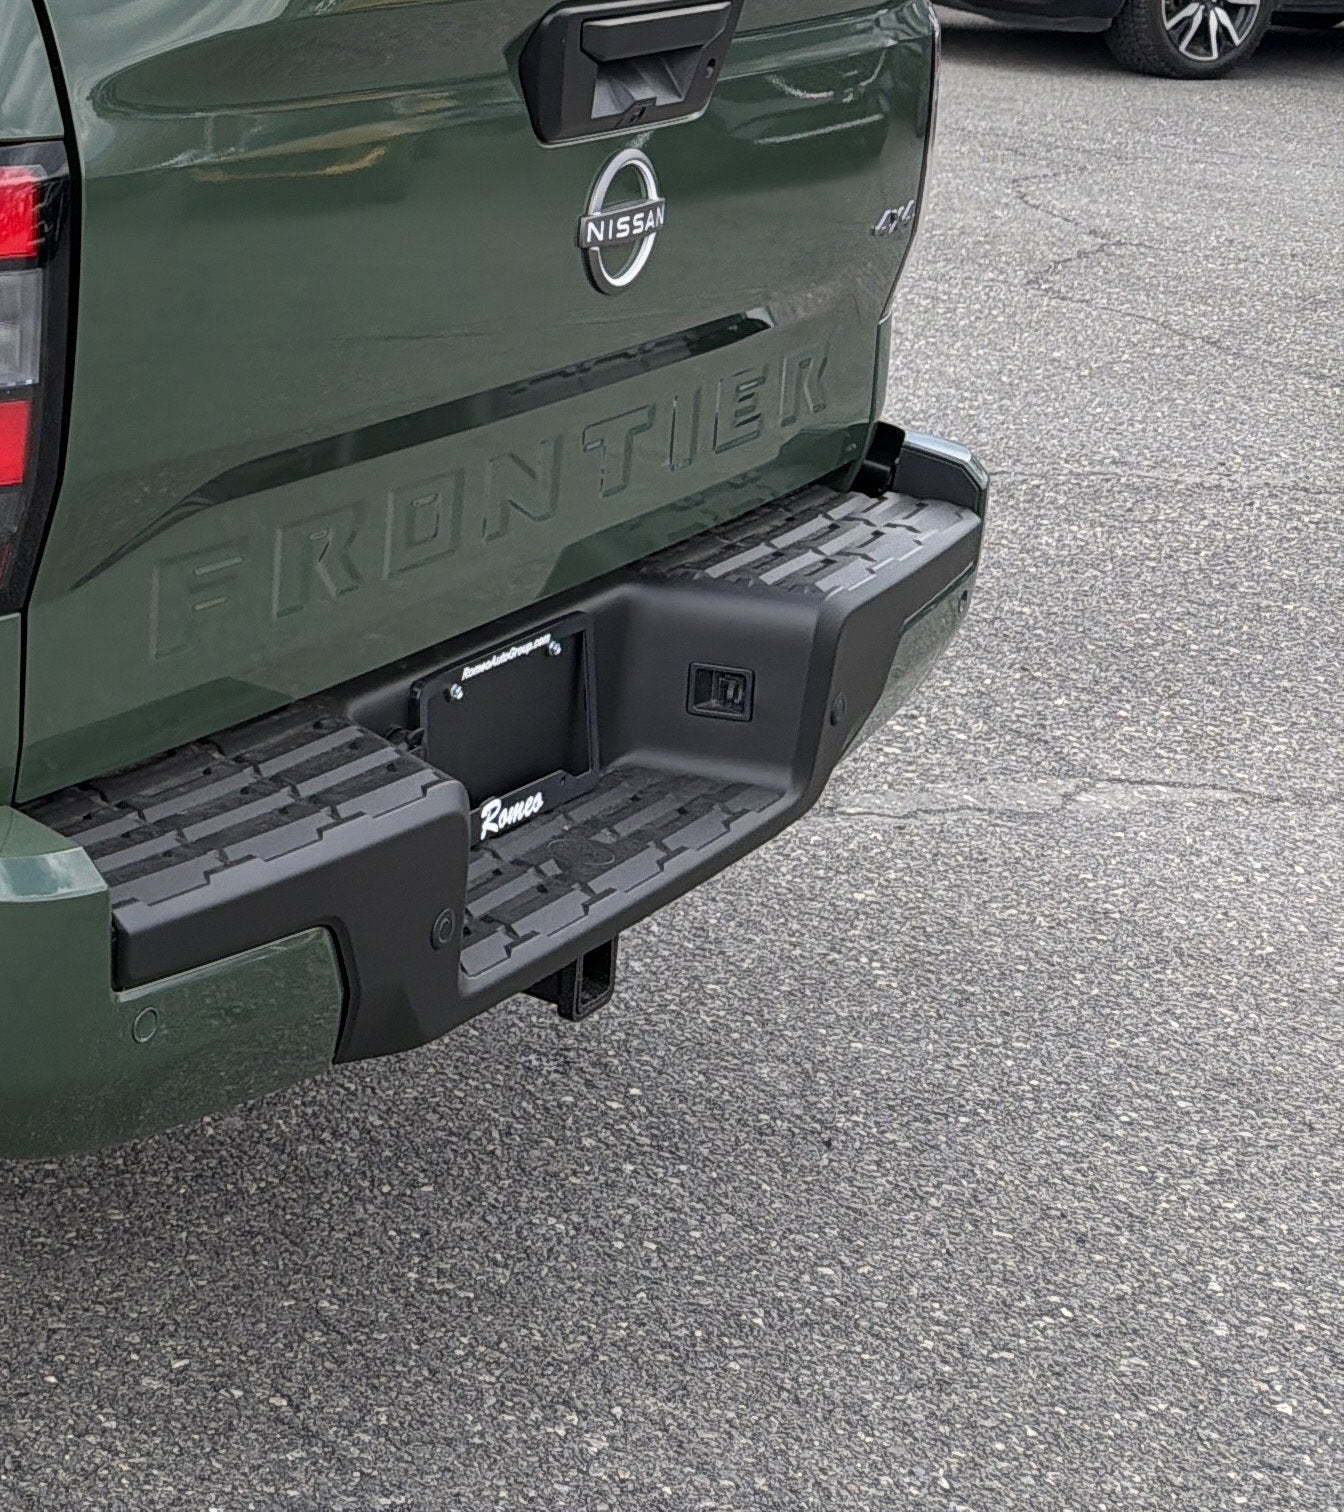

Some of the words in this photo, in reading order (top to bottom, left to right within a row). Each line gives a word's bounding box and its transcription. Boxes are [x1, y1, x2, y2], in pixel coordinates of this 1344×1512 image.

[585, 206, 666, 243] NISSAN
[149, 340, 833, 660] FRONTIER
[461, 633, 551, 681] RomeoAutoGroup.com
[479, 791, 544, 841] Romeo
